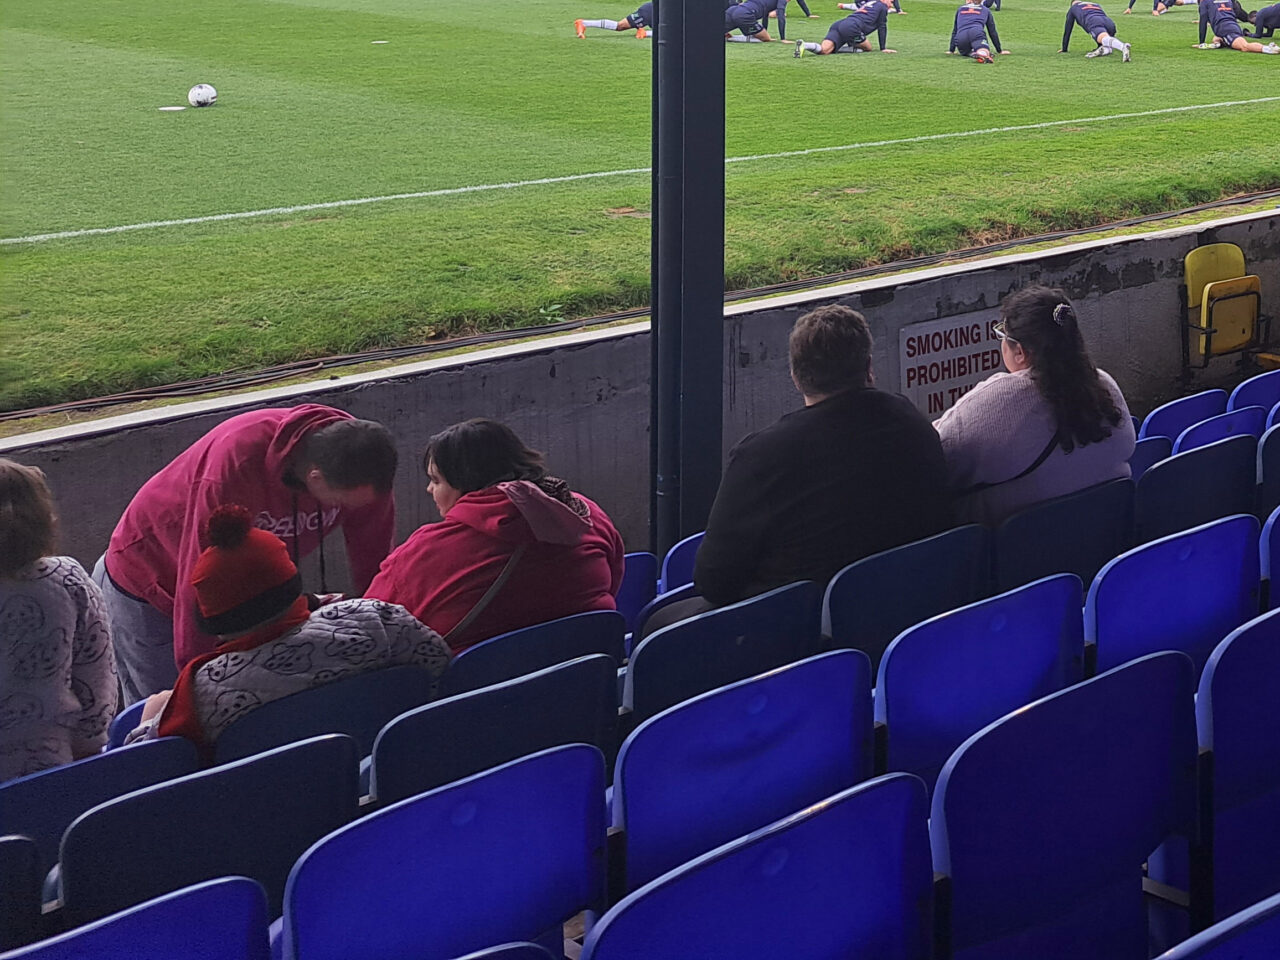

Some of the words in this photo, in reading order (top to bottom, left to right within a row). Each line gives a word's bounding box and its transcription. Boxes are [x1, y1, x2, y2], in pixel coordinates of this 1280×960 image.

[906, 324, 981, 358] SMOKING
[906, 349, 1000, 388] PROHIBITED
[928, 391, 944, 413] IN
